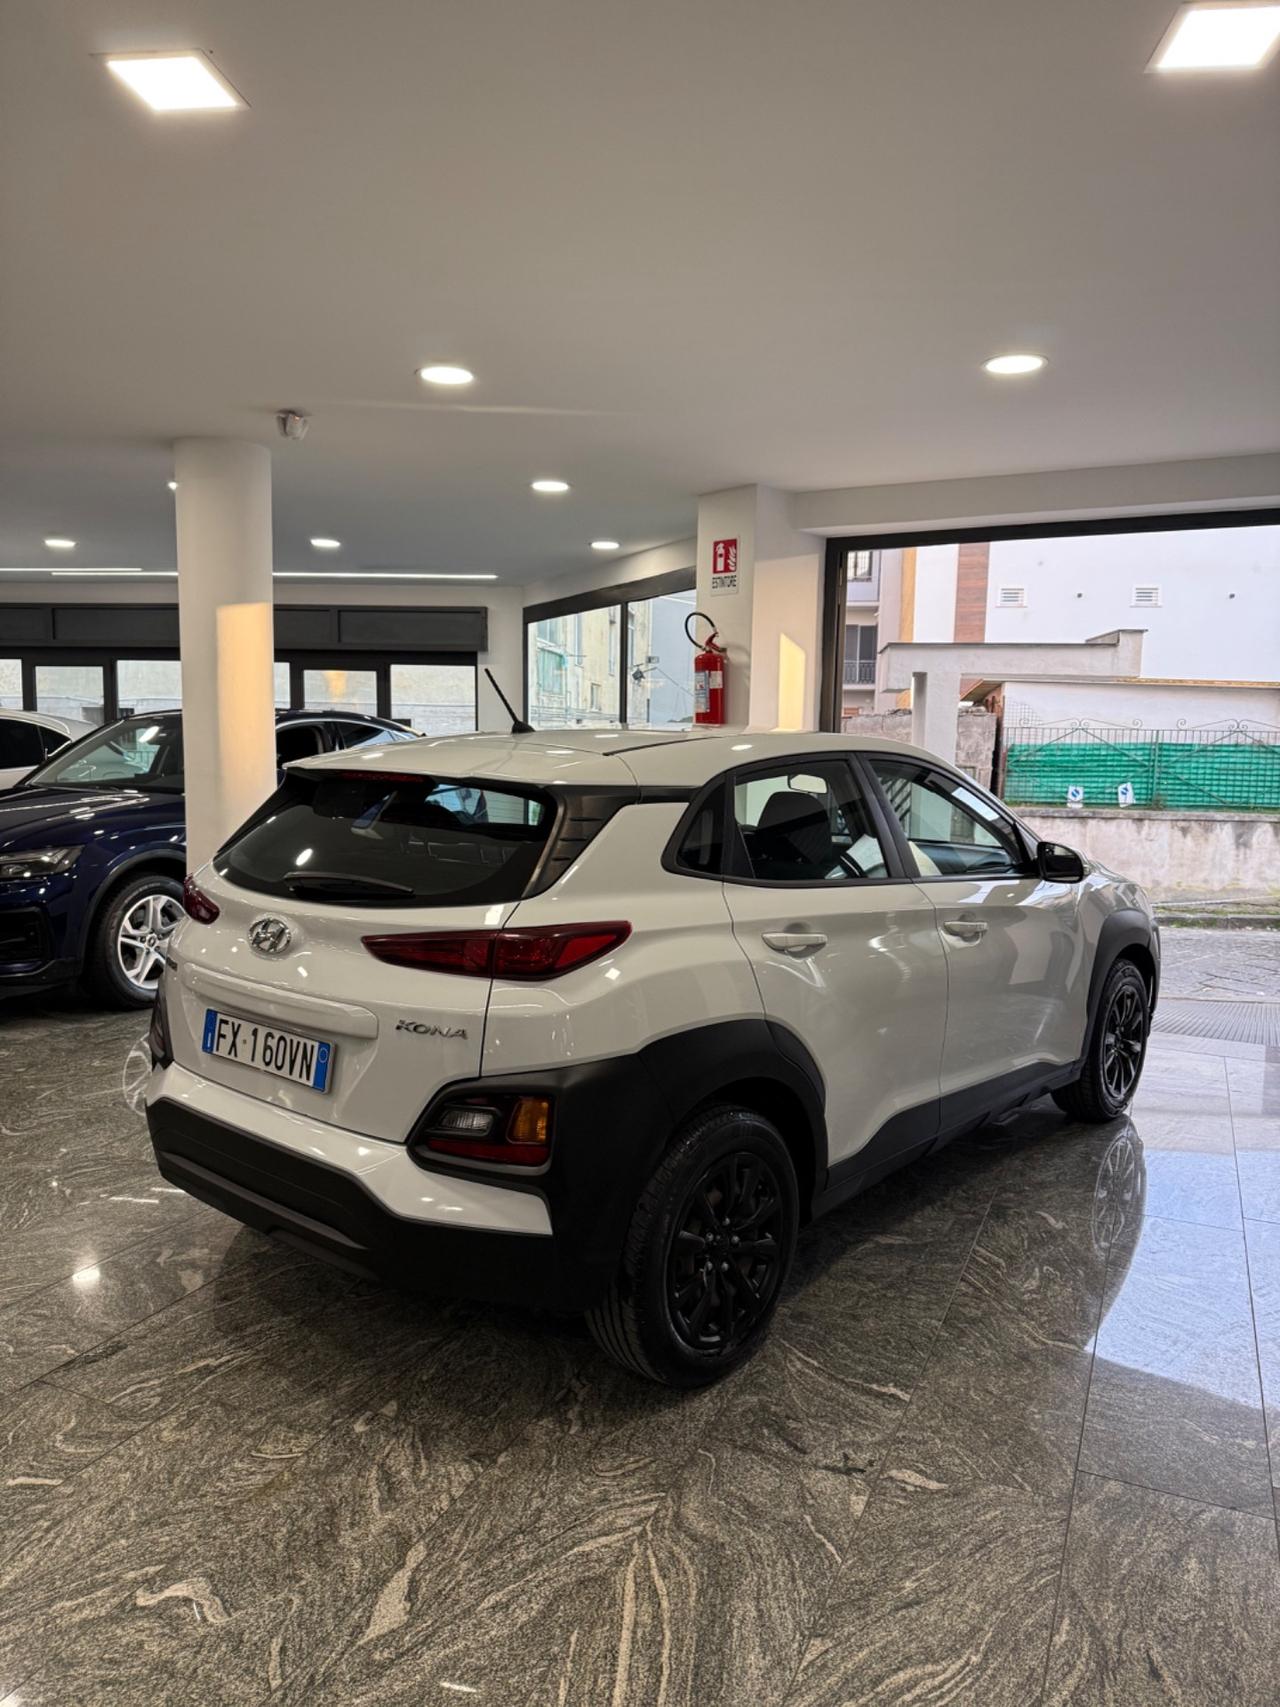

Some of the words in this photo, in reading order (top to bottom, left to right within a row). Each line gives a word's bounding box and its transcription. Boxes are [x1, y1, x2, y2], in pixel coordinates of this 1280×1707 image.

[216, 1018, 241, 1057] FX
[251, 1027, 315, 1081] 160VN
[395, 1019, 468, 1040] KONA
